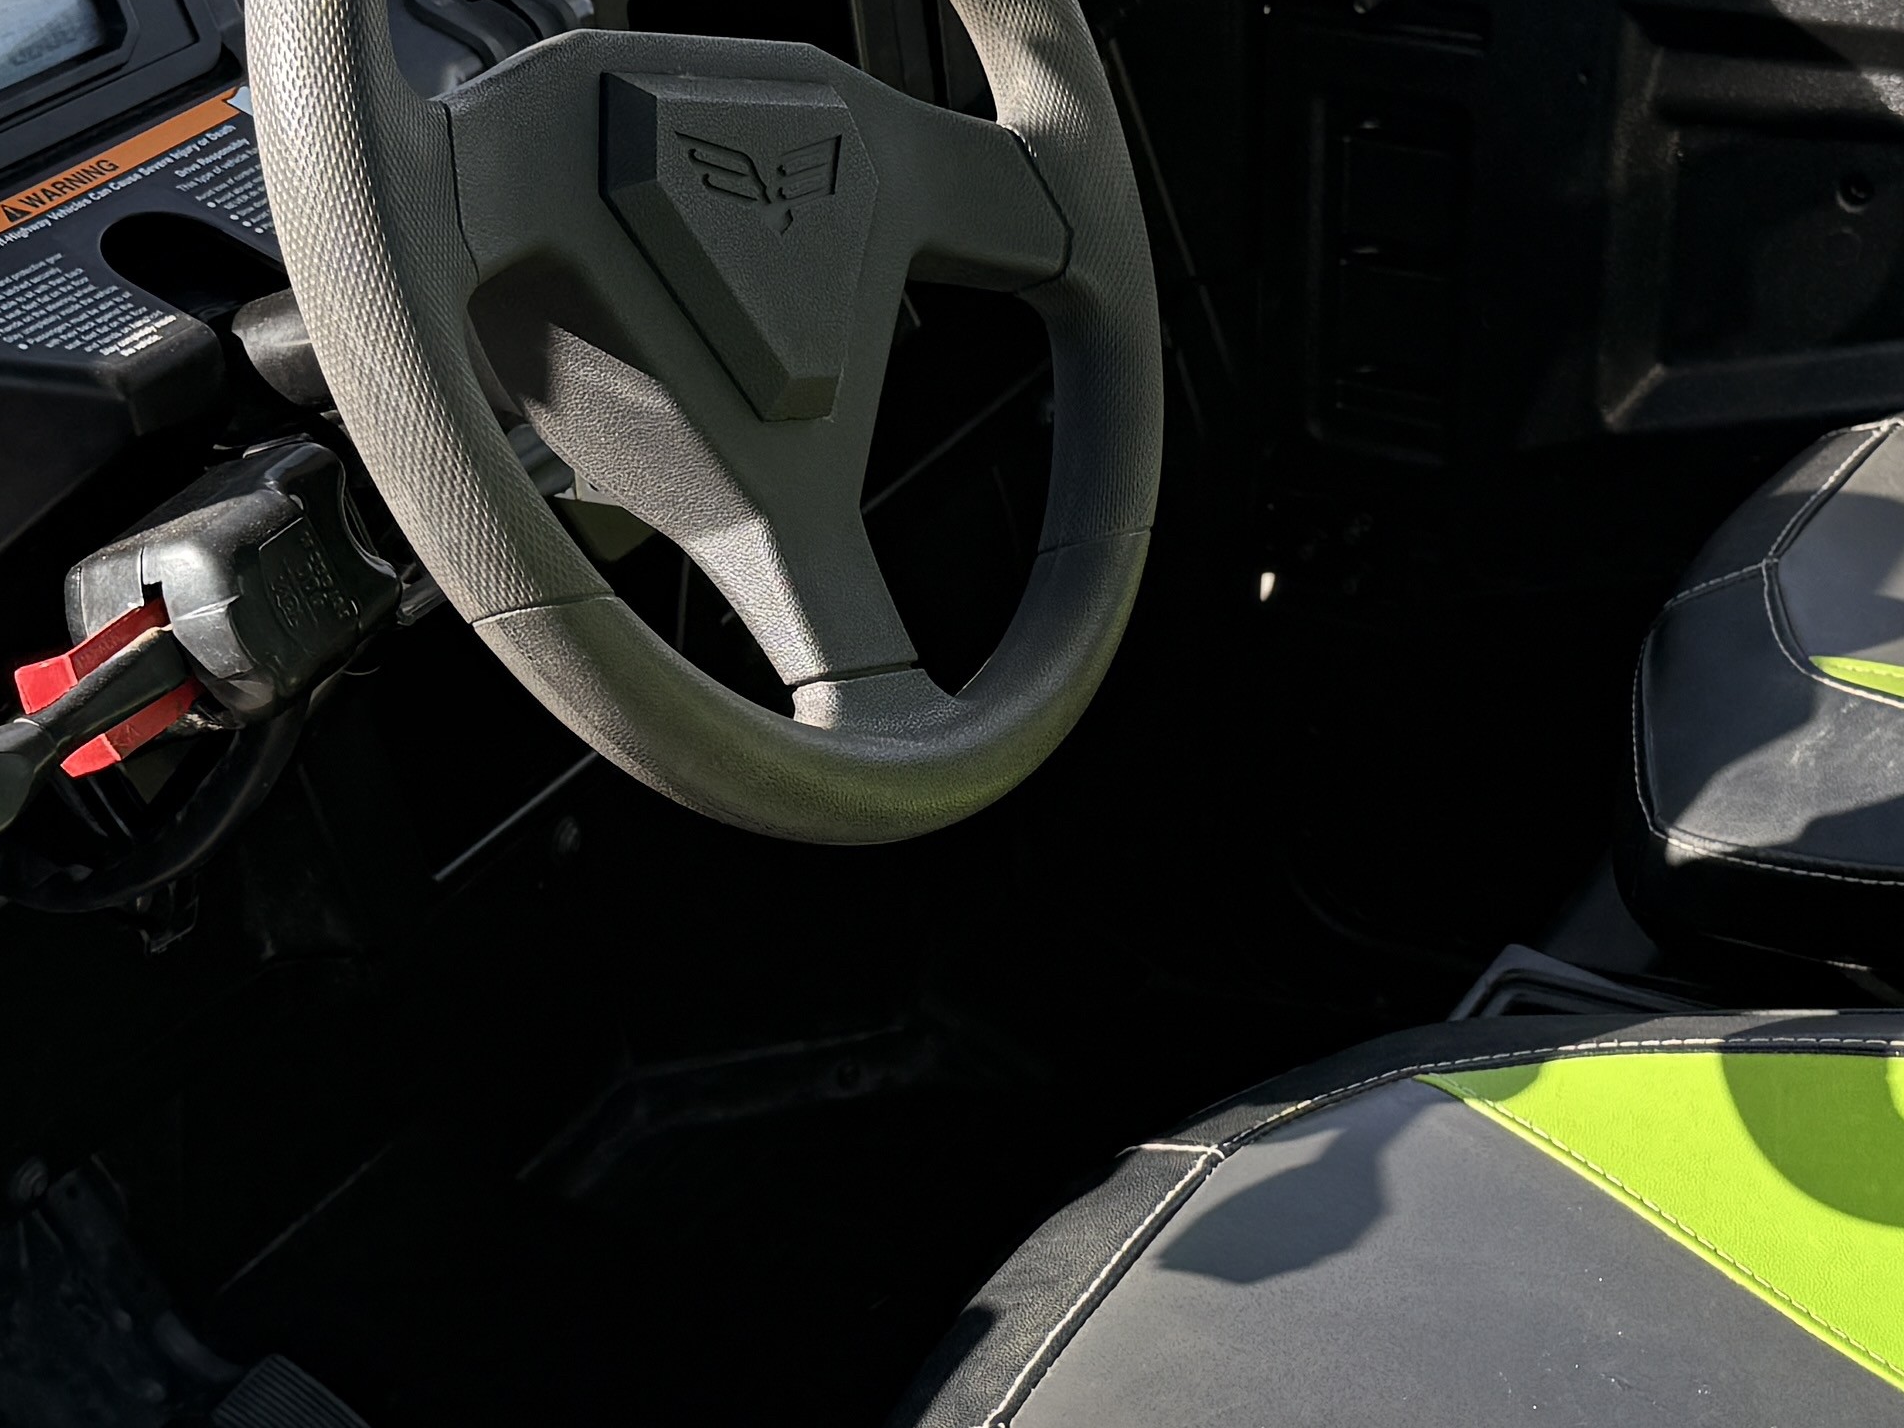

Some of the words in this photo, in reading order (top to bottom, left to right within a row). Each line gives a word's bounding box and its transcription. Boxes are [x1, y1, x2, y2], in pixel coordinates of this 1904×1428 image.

[18, 159, 120, 210] WARNING
[46, 198, 91, 220] Vehicles
[87, 188, 112, 200] Can
[108, 172, 142, 190] Cause
[137, 156, 174, 175] Severe
[169, 143, 200, 159] Injury
[197, 137, 209, 145] or
[205, 125, 236, 140] Death
